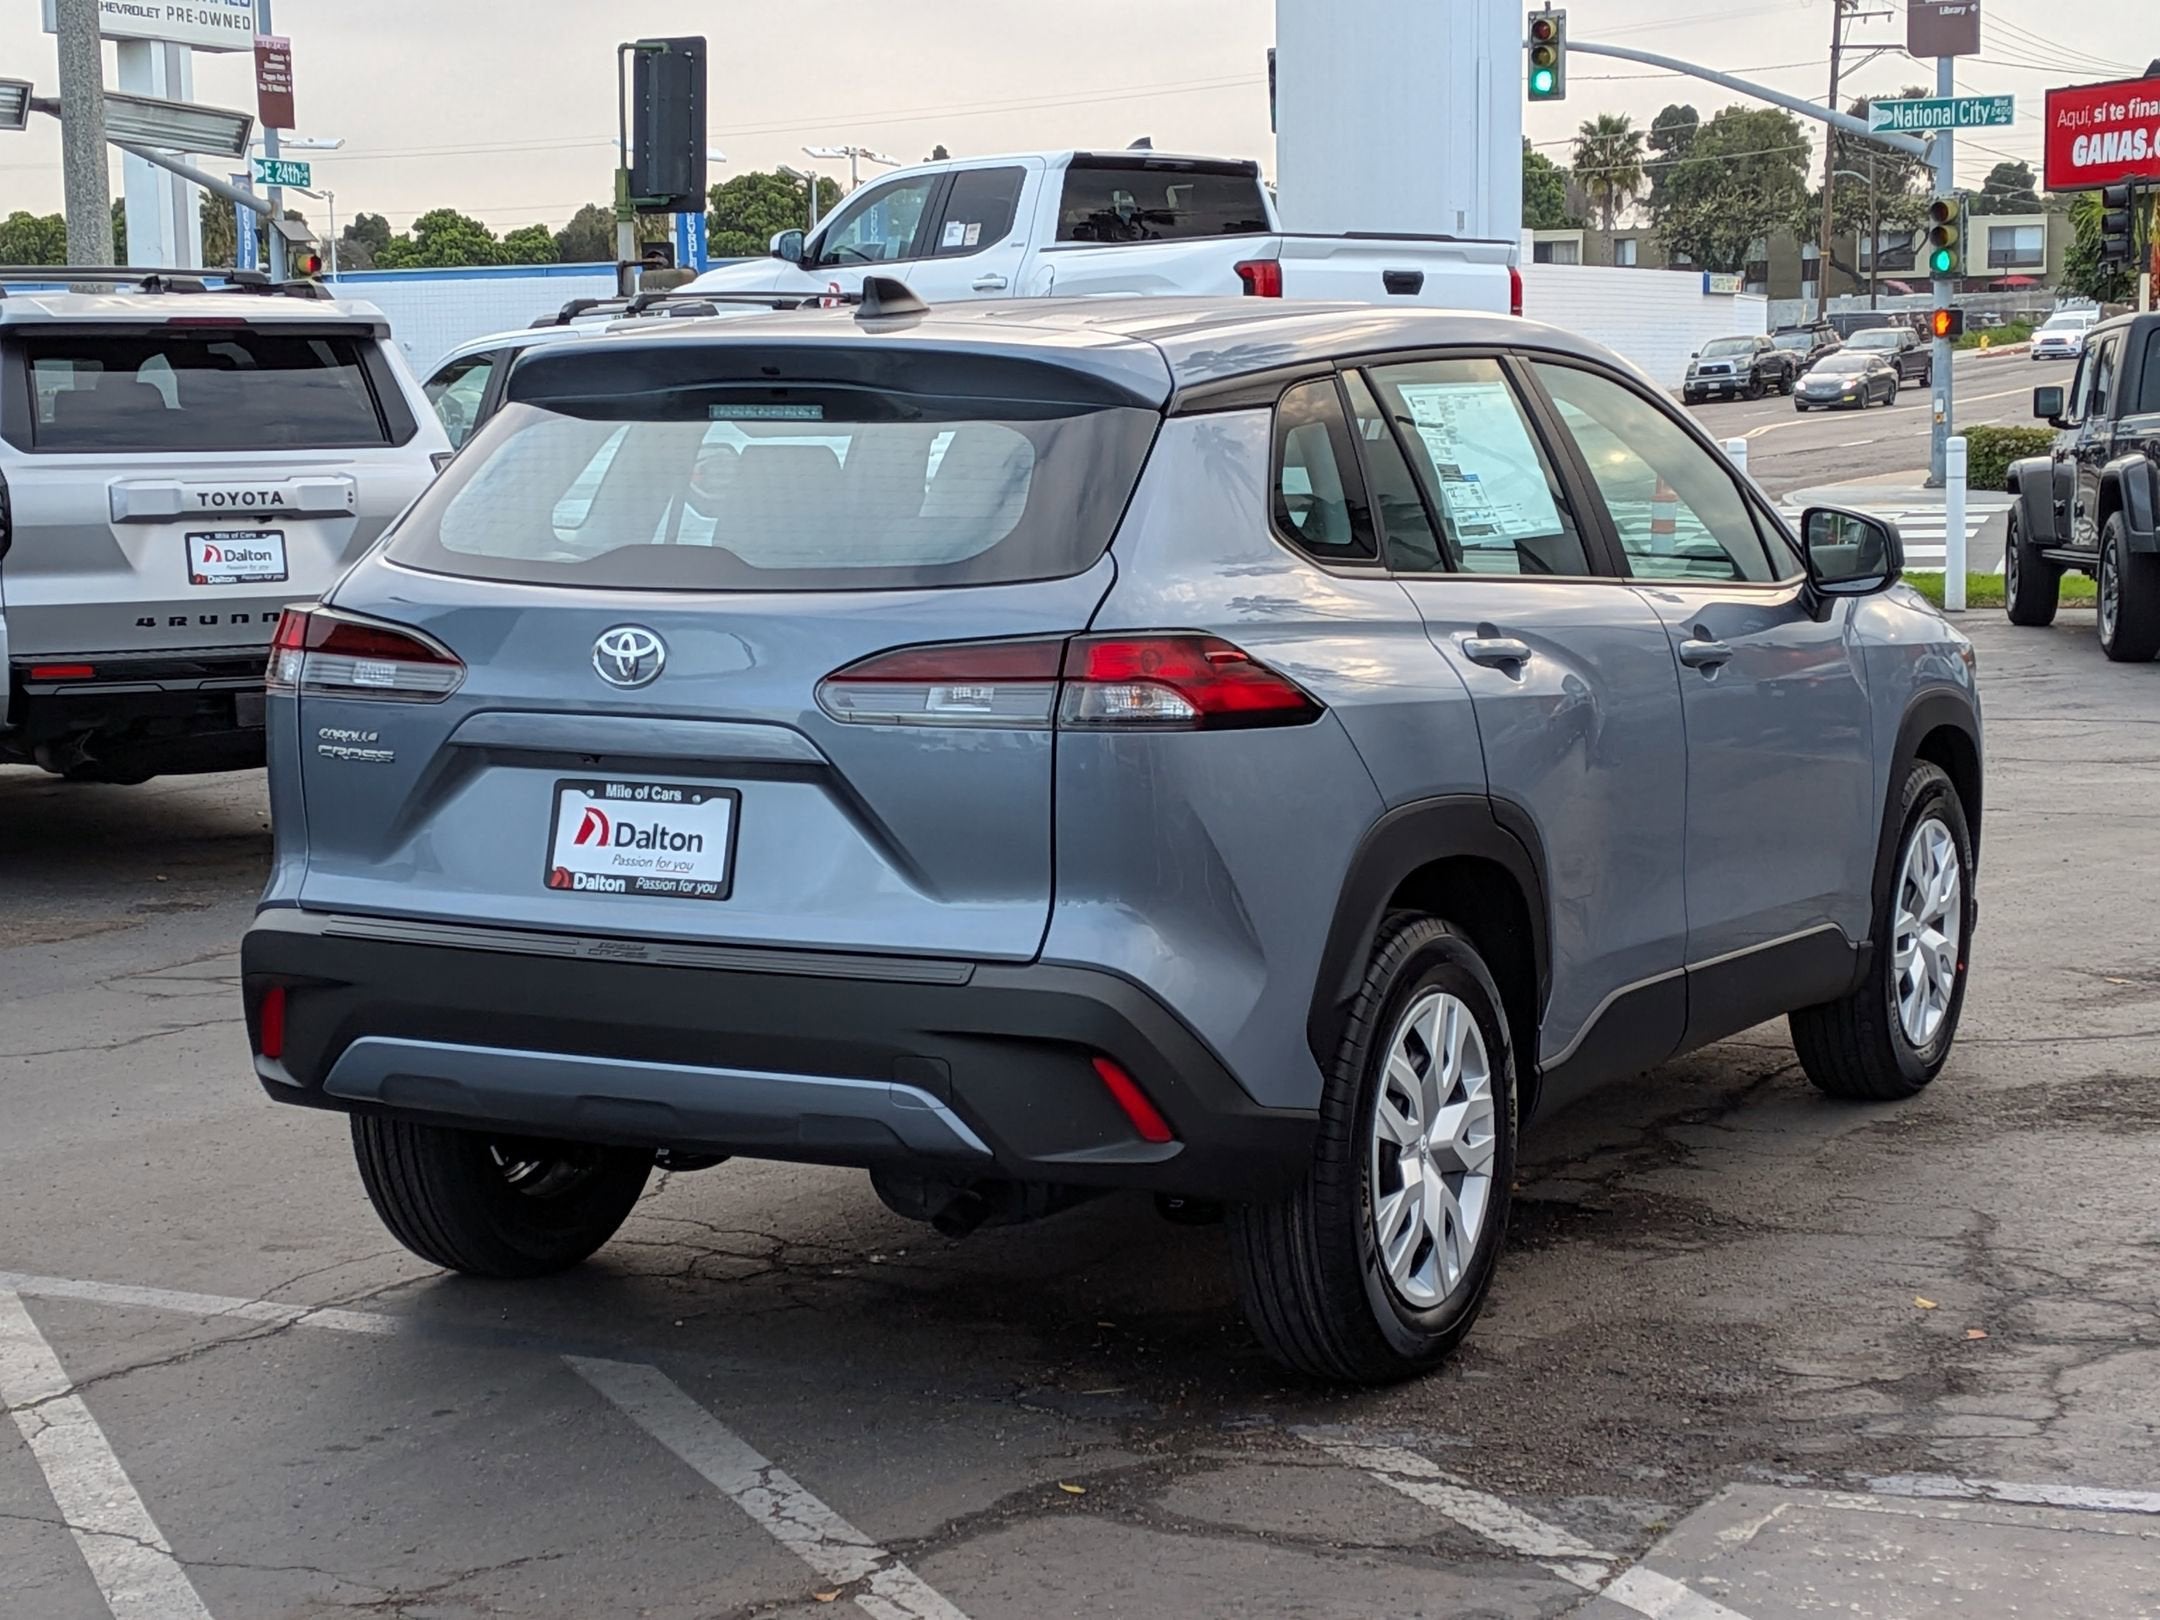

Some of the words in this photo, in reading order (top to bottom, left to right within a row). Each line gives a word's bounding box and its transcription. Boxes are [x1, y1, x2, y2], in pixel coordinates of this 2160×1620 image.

[166, 6, 250, 30] PRE-OWNED
[1939, 6, 1967, 15] Library
[1893, 101, 1956, 128] National
[1960, 100, 1990, 125] City
[2057, 105, 2092, 130] Aquí,
[2094, 102, 2108, 123] sí
[2109, 103, 2126, 121] te
[2128, 97, 2160, 119] fina
[264, 162, 274, 182] E
[275, 163, 300, 184] 24th
[197, 491, 284, 506] TOYOTA
[224, 548, 272, 562] Dalton
[606, 783, 632, 798] Mile
[634, 785, 649, 799] of
[651, 786, 682, 801] Cars
[614, 821, 703, 853] Dalton
[612, 853, 653, 867] Passion
[656, 856, 672, 869] for
[673, 862, 695, 872] you
[573, 872, 626, 893] Dalton
[635, 877, 676, 891] Passion
[678, 879, 697, 892] for
[695, 883, 718, 895] you
